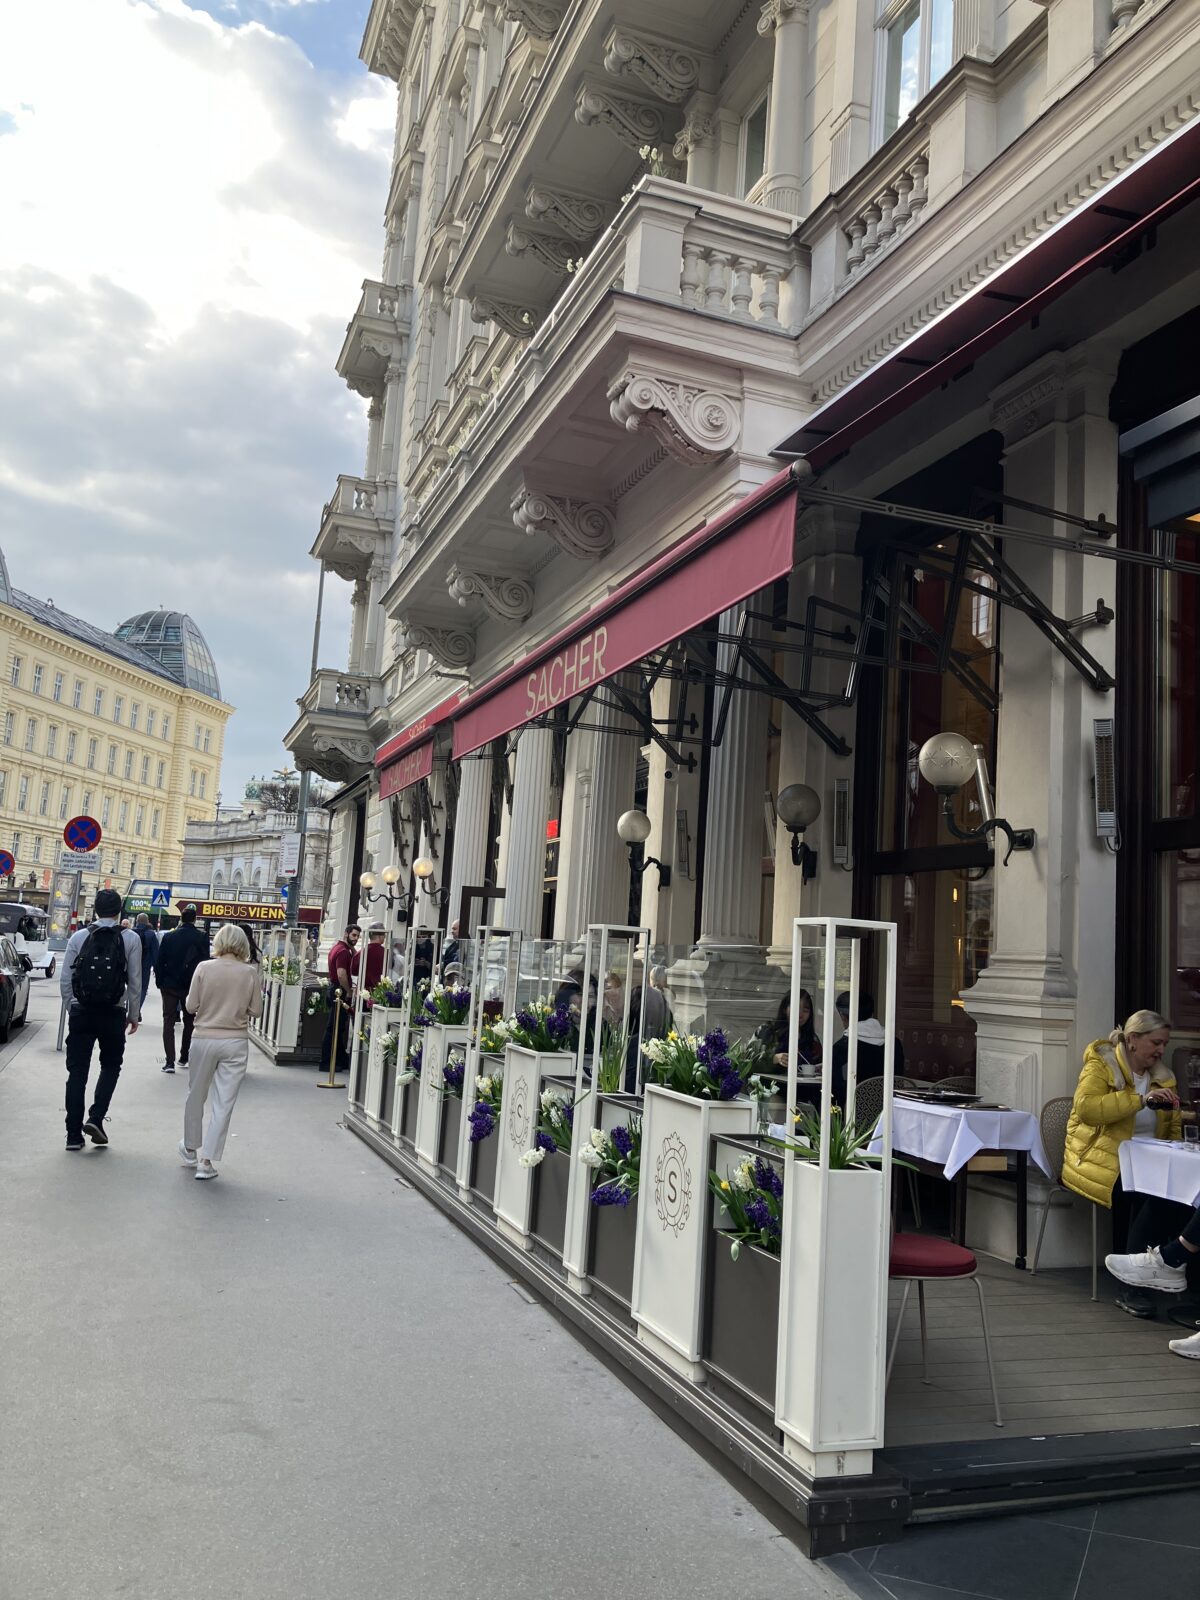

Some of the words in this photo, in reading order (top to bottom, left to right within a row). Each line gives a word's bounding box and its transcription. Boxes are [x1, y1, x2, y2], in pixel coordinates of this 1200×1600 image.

[526, 626, 607, 717] SACHER
[131, 899, 151, 908] 100%
[248, 907, 286, 920] VIENN
[667, 1170, 677, 1203] S
